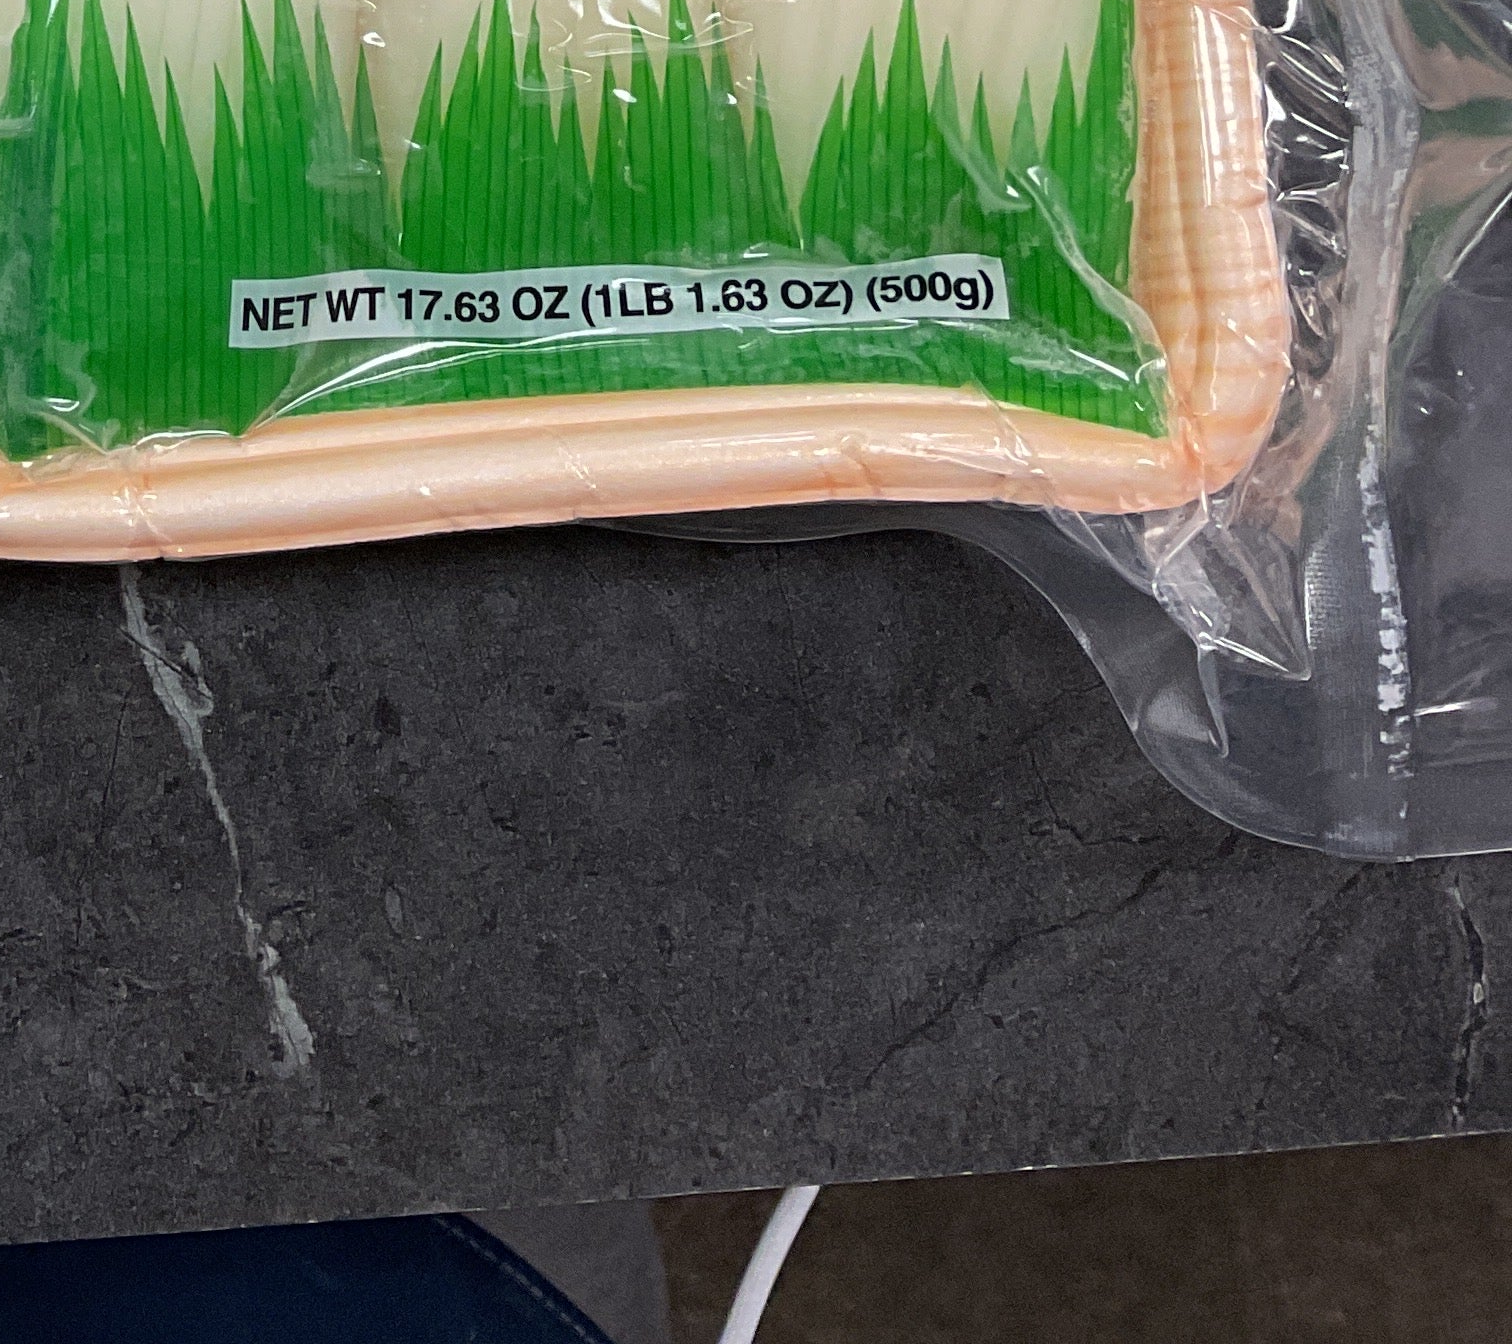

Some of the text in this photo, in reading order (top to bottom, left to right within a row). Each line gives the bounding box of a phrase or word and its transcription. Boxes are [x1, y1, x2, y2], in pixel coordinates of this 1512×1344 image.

[241, 270, 994, 332] NET WT 17.63 OZ (1LB 1.63 OZ) (500g)
